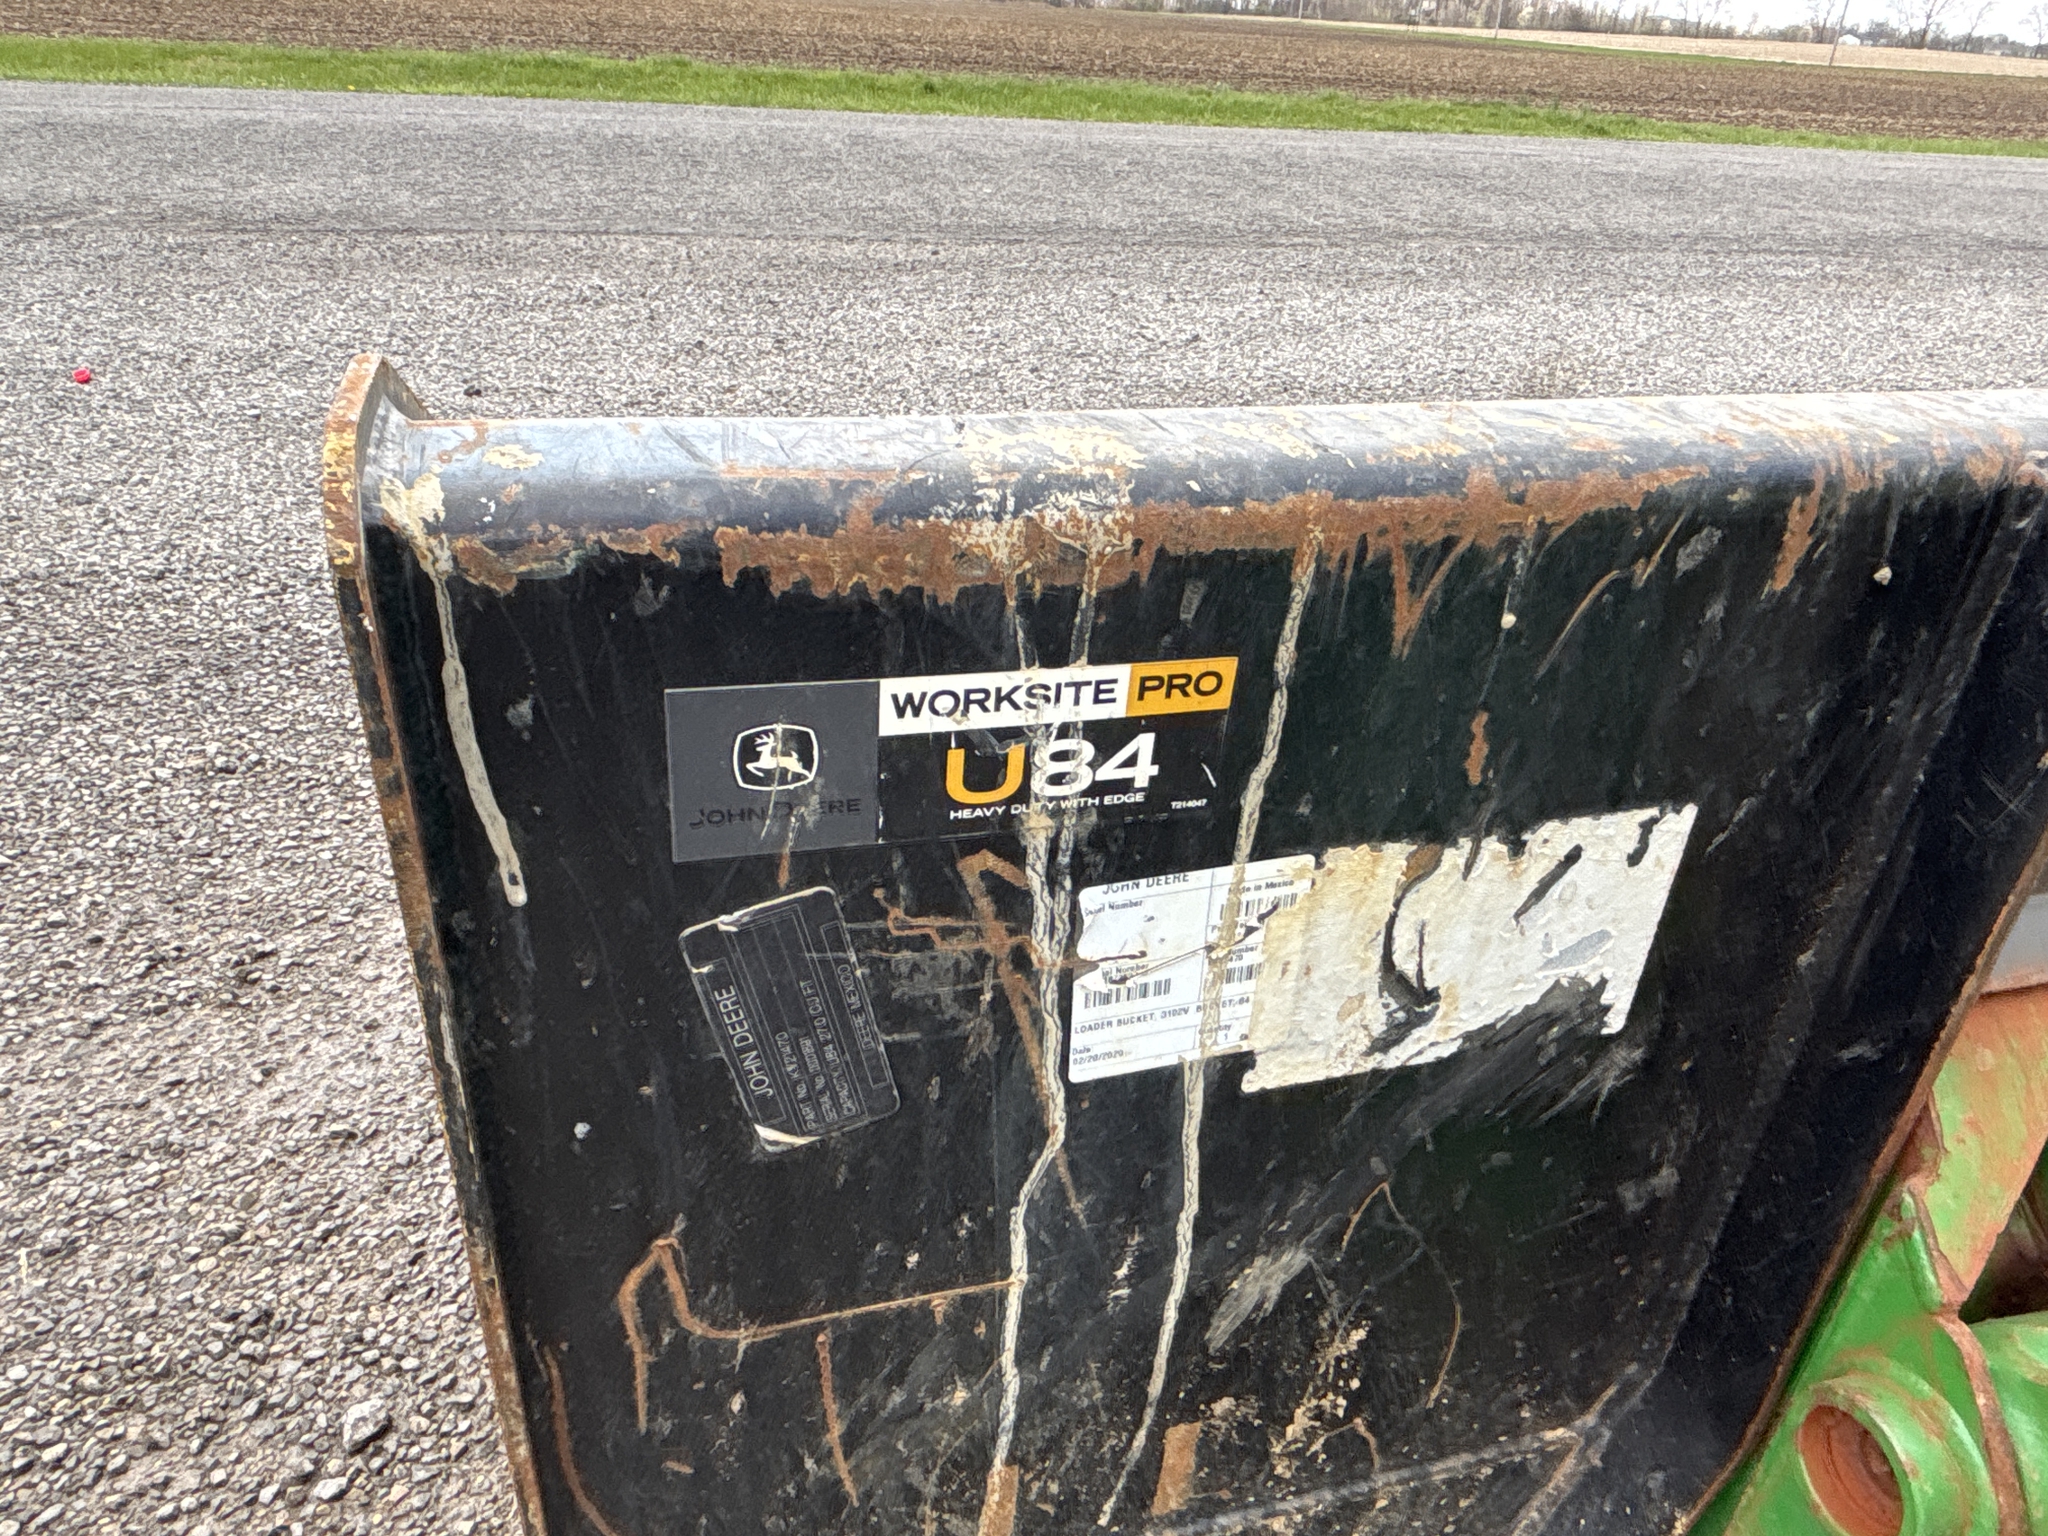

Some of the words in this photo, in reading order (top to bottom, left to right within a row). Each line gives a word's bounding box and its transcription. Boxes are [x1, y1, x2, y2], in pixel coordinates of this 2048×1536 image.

[891, 678, 1118, 719] WORKSITE
[1136, 671, 1222, 701] PRO
[945, 732, 1159, 805] U84
[689, 806, 769, 828] JOHN
[774, 798, 861, 818] DERE
[949, 805, 1006, 820] HEAVY
[1011, 801, 1055, 815] DUTY
[1060, 796, 1100, 810] WITH
[1104, 792, 1146, 805] EDGE
[1170, 798, 1208, 810] T214047
[1146, 873, 1190, 889] DEERE
[1264, 879, 1295, 890] Mexico
[1108, 899, 1143, 910] Number
[1226, 945, 1259, 956] umber
[713, 984, 753, 1048] DEERE
[1074, 1020, 1113, 1035] LOADER
[738, 1049, 774, 1101] JOHN
[799, 1099, 820, 1129] PART
